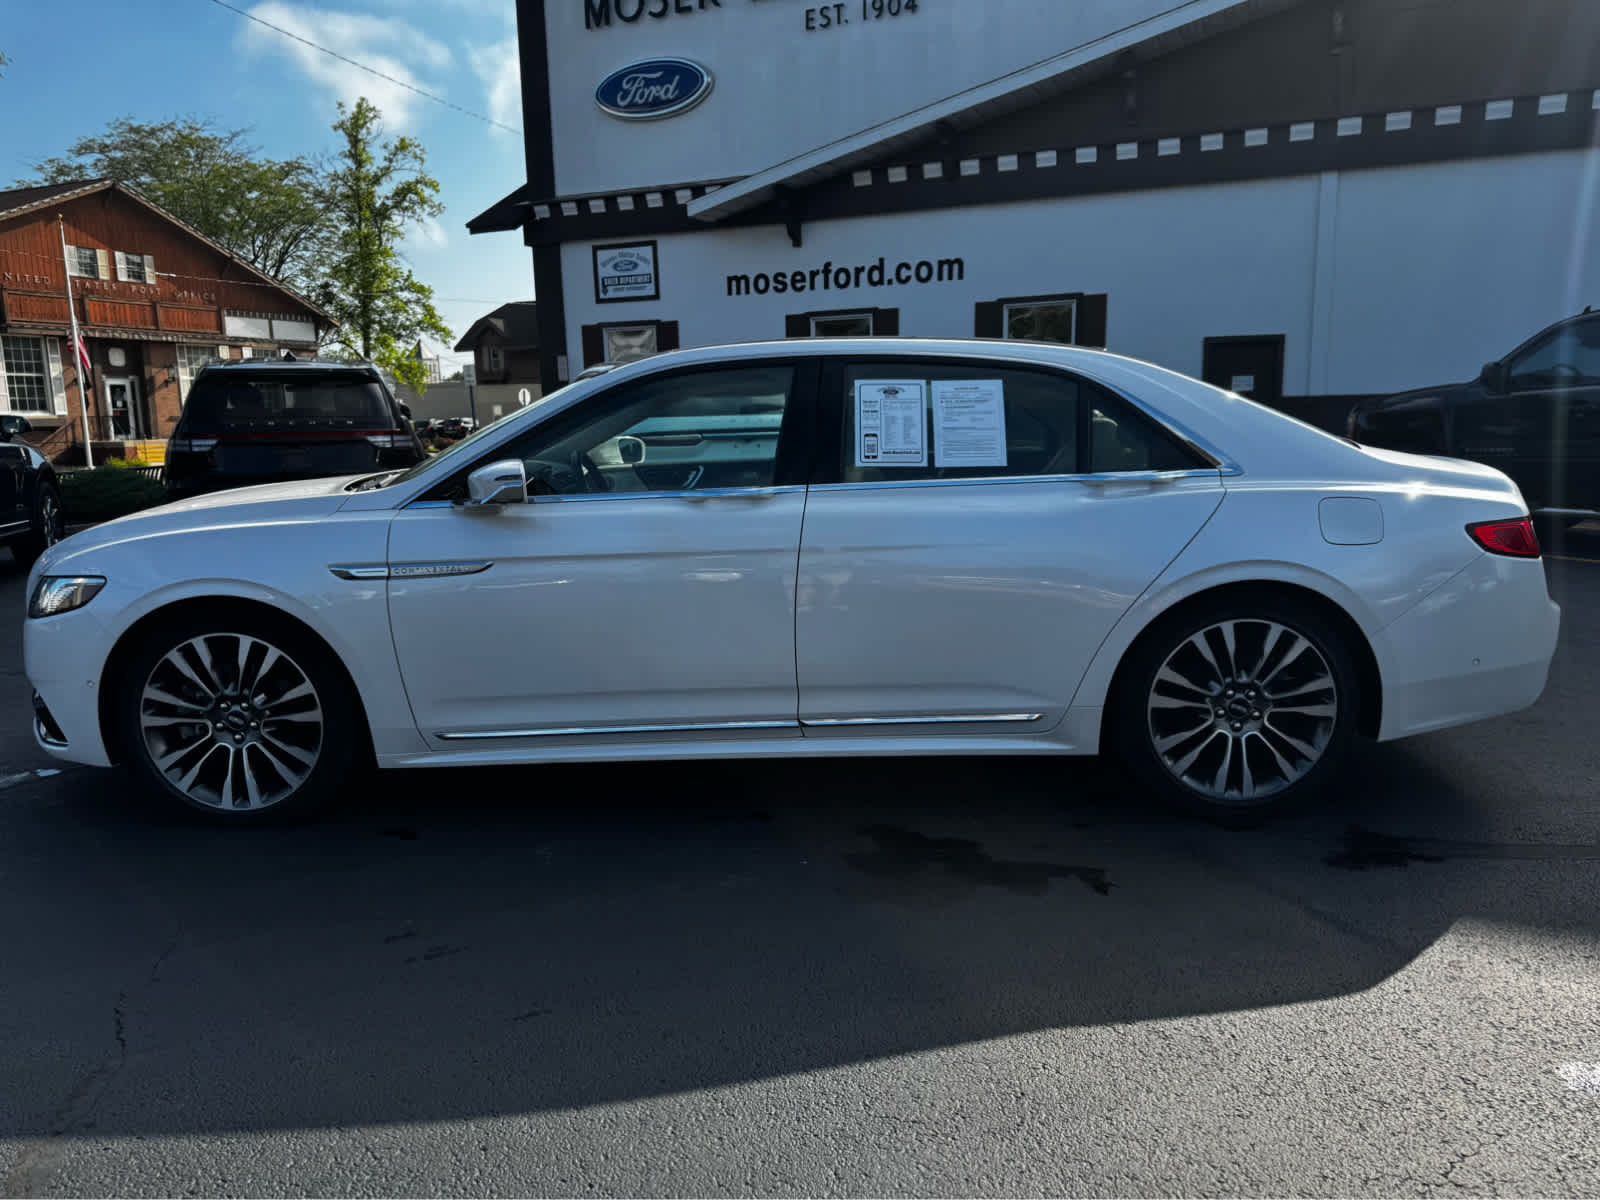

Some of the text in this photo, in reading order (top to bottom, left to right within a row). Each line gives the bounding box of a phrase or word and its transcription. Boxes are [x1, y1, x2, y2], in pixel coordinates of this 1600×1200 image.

[584, 0, 722, 30] MOS
[805, 0, 918, 31] EST. 1904
[617, 71, 680, 107] Ford
[727, 257, 964, 296] moserford.com
